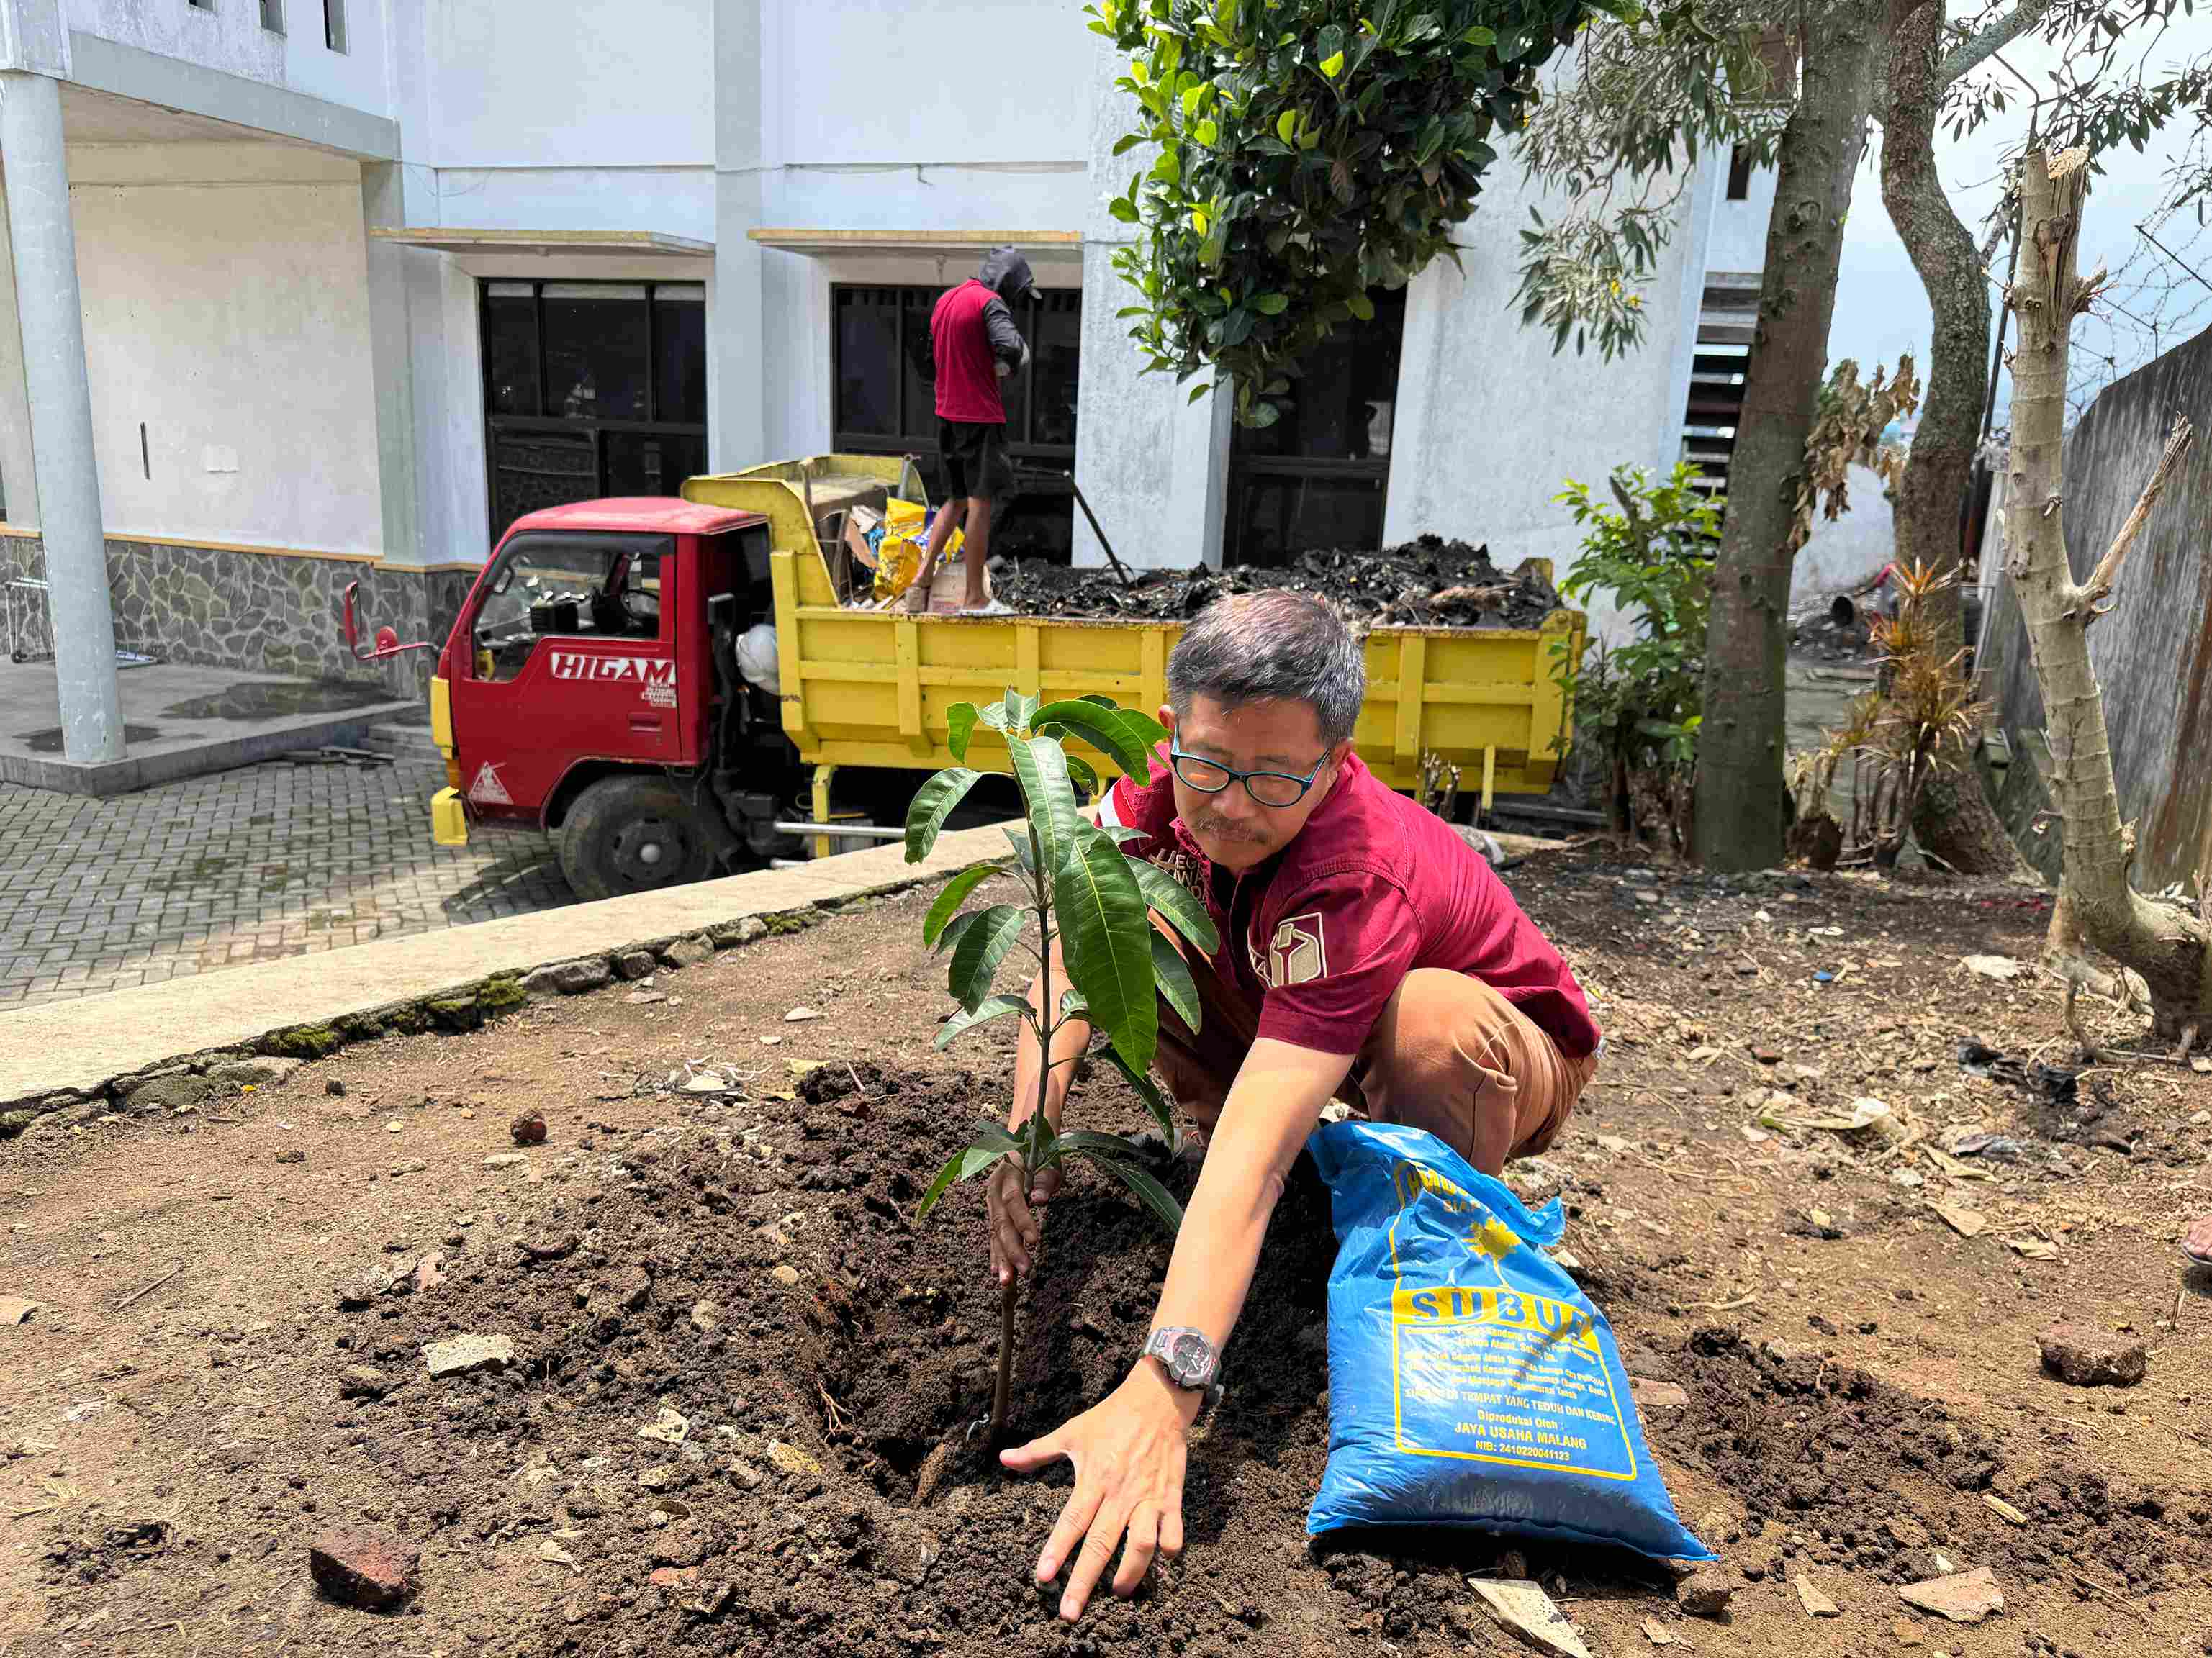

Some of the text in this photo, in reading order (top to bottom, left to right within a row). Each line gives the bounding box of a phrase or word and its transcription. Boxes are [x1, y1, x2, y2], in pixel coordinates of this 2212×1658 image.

[551, 653, 676, 684] HIGAM
[1463, 1392, 1502, 1405] TEMPAT
[1504, 1395, 1530, 1410] YANG
[1531, 1400, 1564, 1415] TEDUH
[1566, 1405, 1584, 1418] DAN
[1454, 1421, 1588, 1451] JAYA USAHA MALANG
[1475, 1439, 1497, 1452] NIB:
